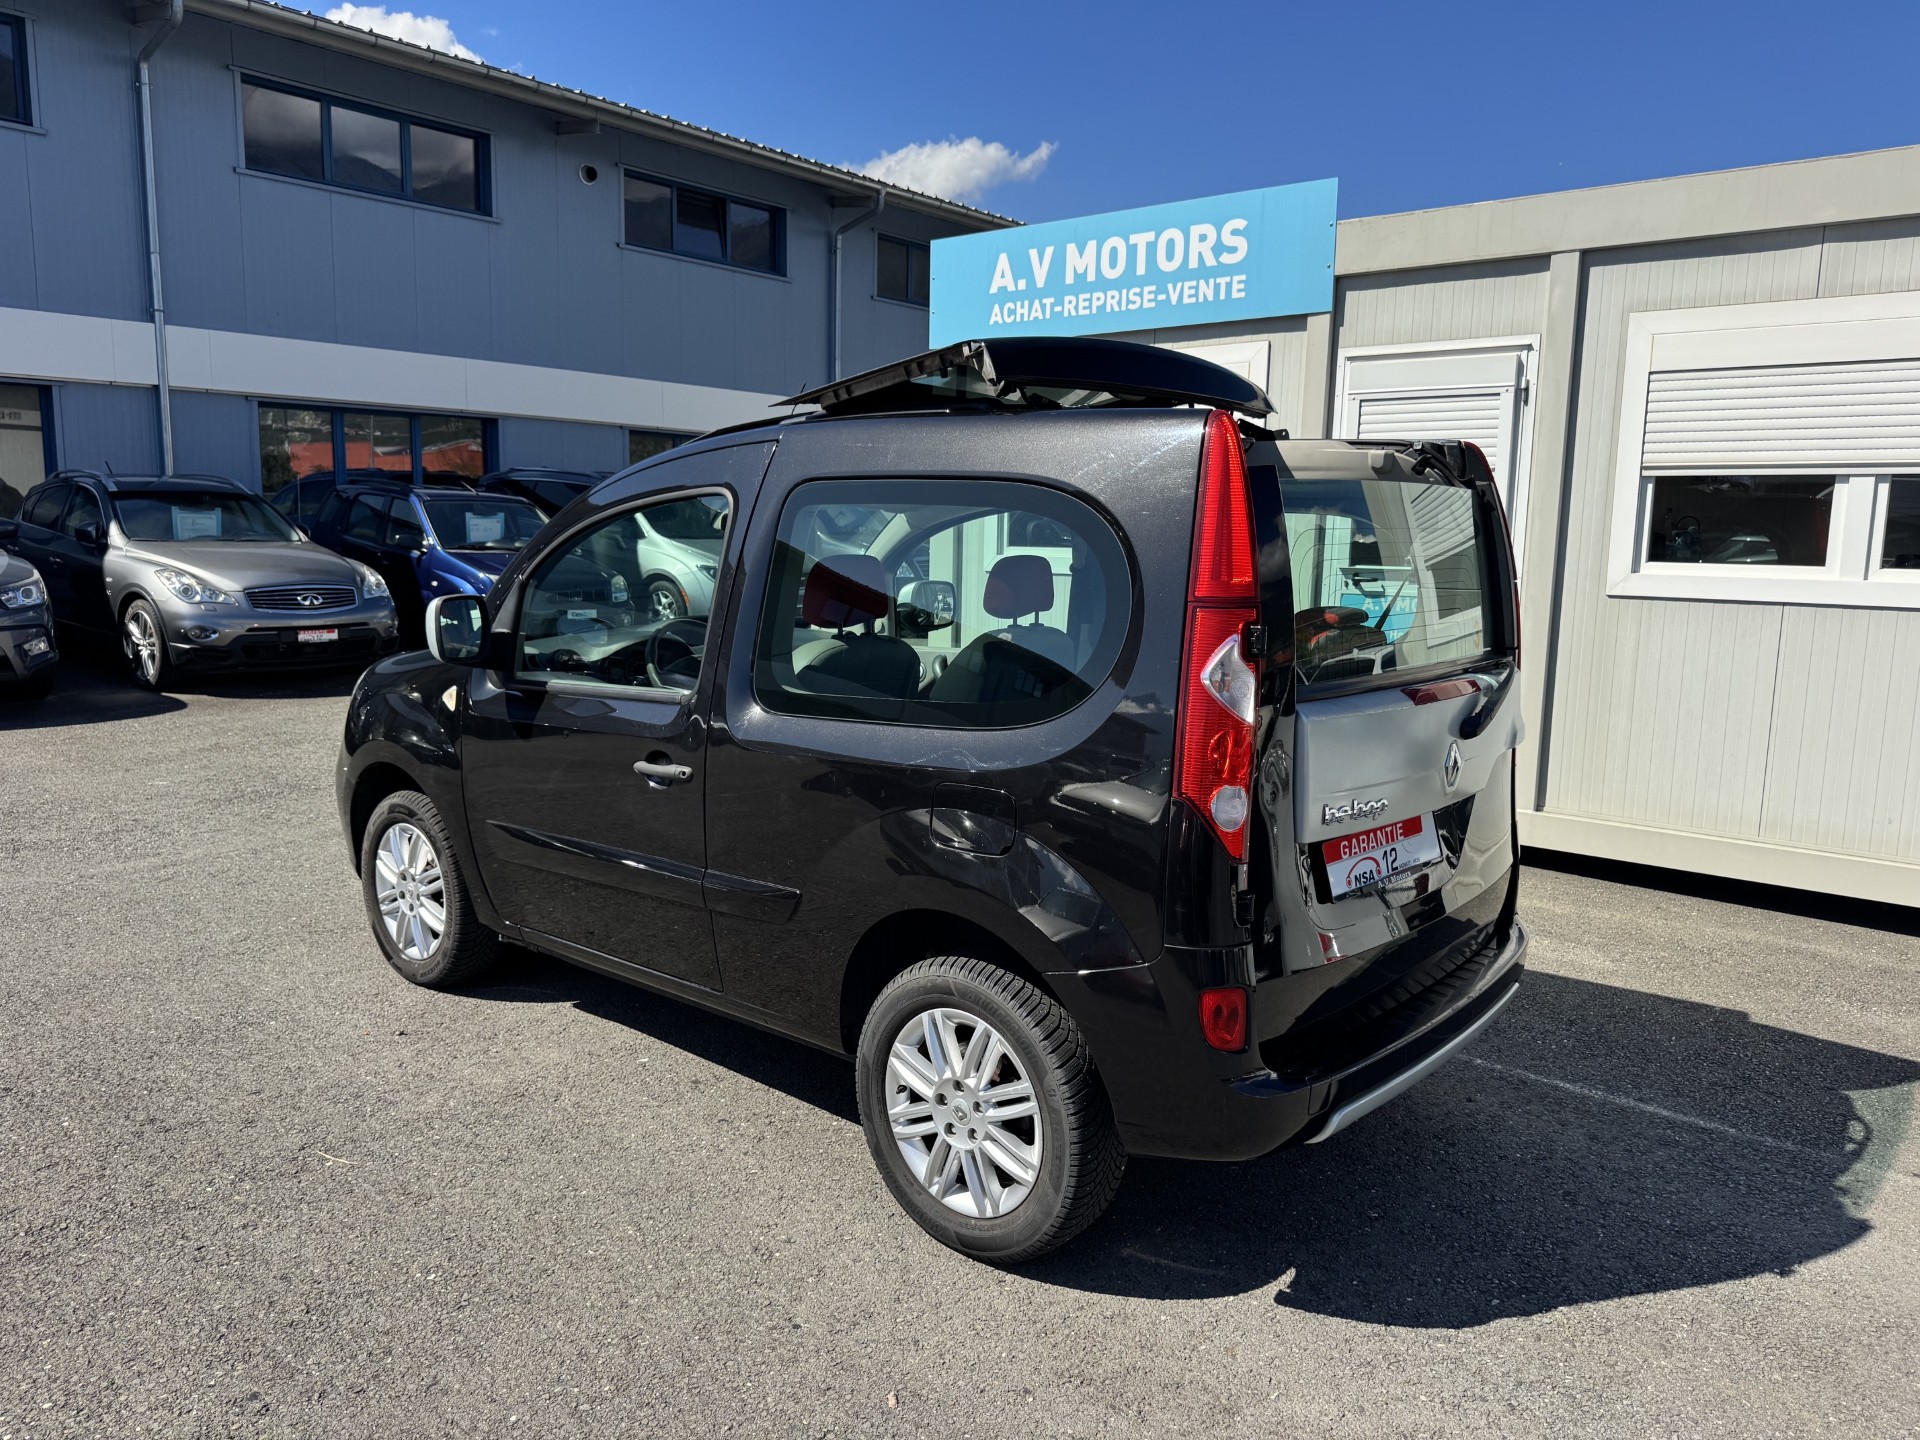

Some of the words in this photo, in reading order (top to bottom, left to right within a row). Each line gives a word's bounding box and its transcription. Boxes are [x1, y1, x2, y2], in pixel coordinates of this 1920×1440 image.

[989, 245, 1055, 295] A.V
[1065, 218, 1249, 285] MOTORS
[989, 274, 1247, 326] ACHAT-REPRISE-VENTE
[1340, 823, 1404, 860] GARANTIE
[1382, 847, 1399, 874] 12
[1354, 869, 1376, 888] NSA
[1391, 871, 1412, 884] Motors
